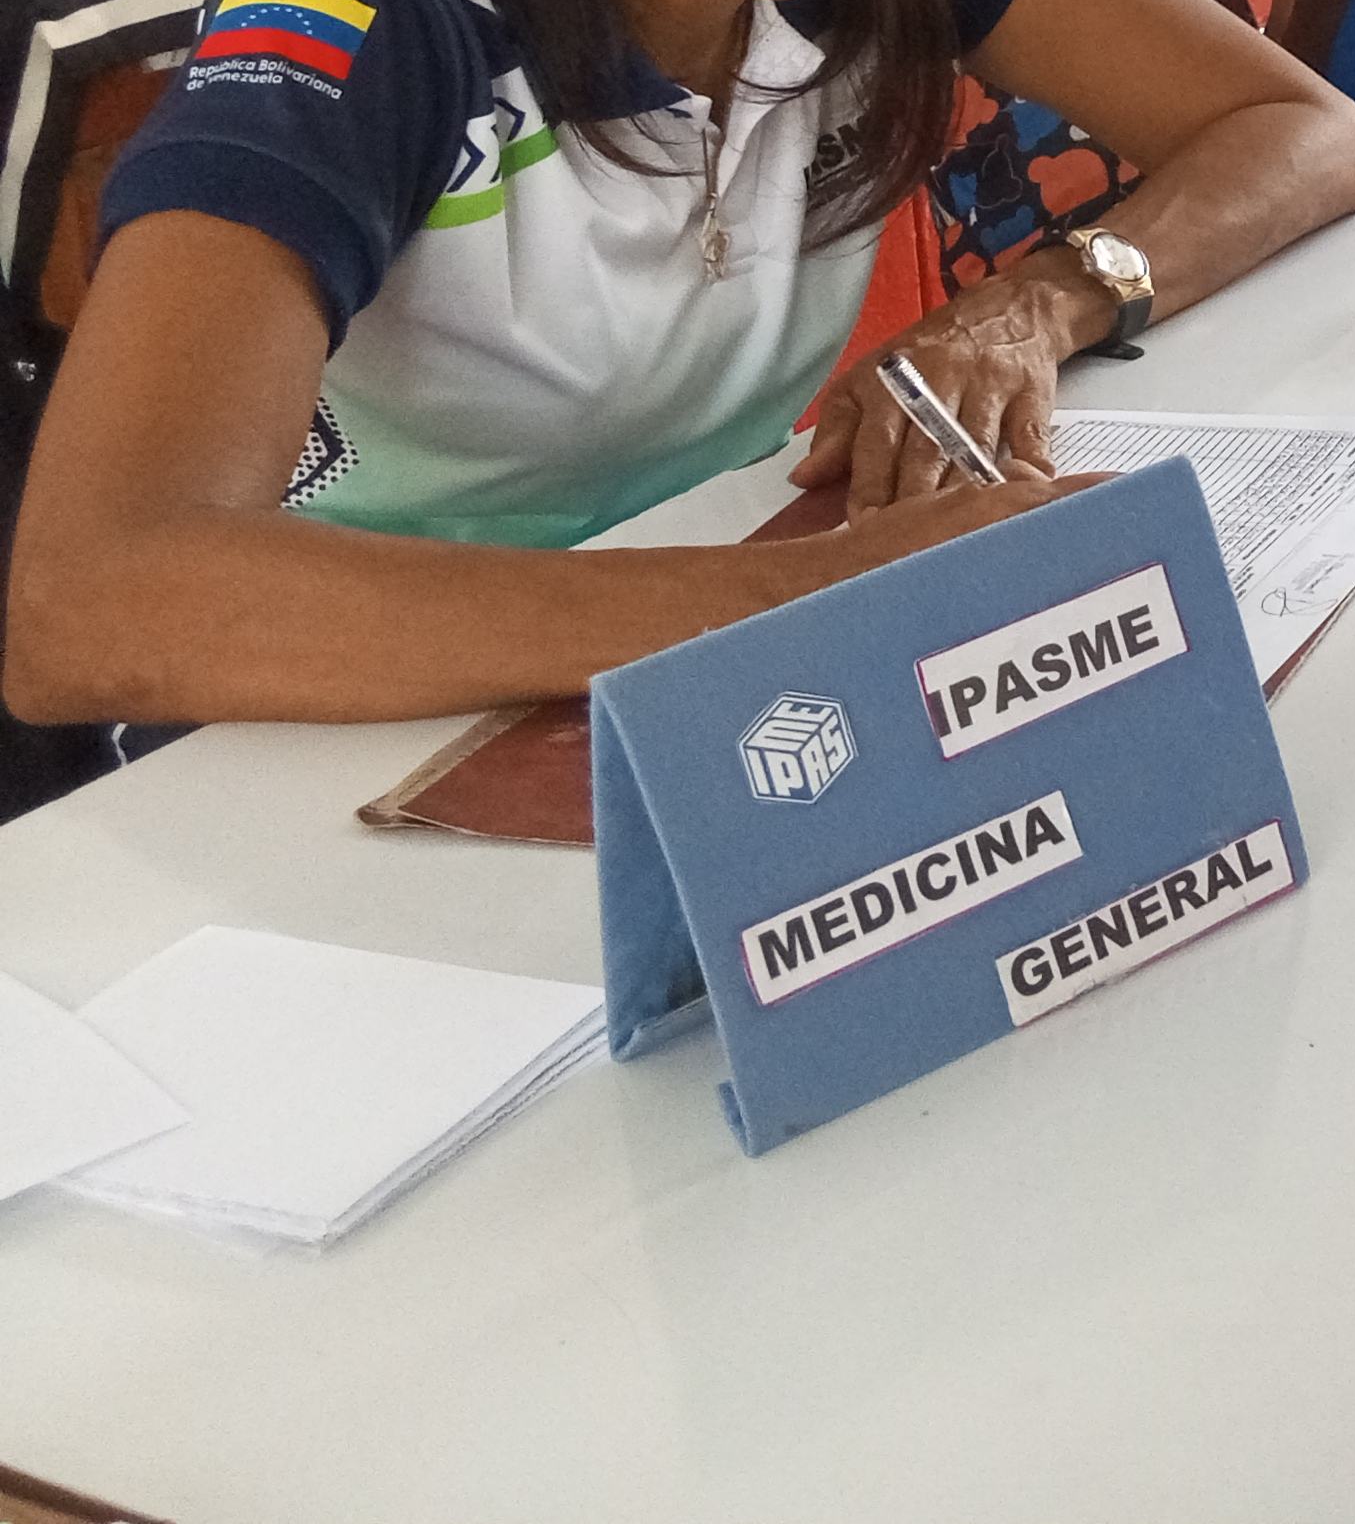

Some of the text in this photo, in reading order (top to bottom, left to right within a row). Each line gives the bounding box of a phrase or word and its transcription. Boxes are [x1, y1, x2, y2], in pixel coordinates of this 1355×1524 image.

[258, 59, 343, 100] Bolivariana
[925, 603, 1161, 738] IPASME
[757, 806, 1067, 981] MEDICINA
[1010, 839, 1274, 998] GENERAL
